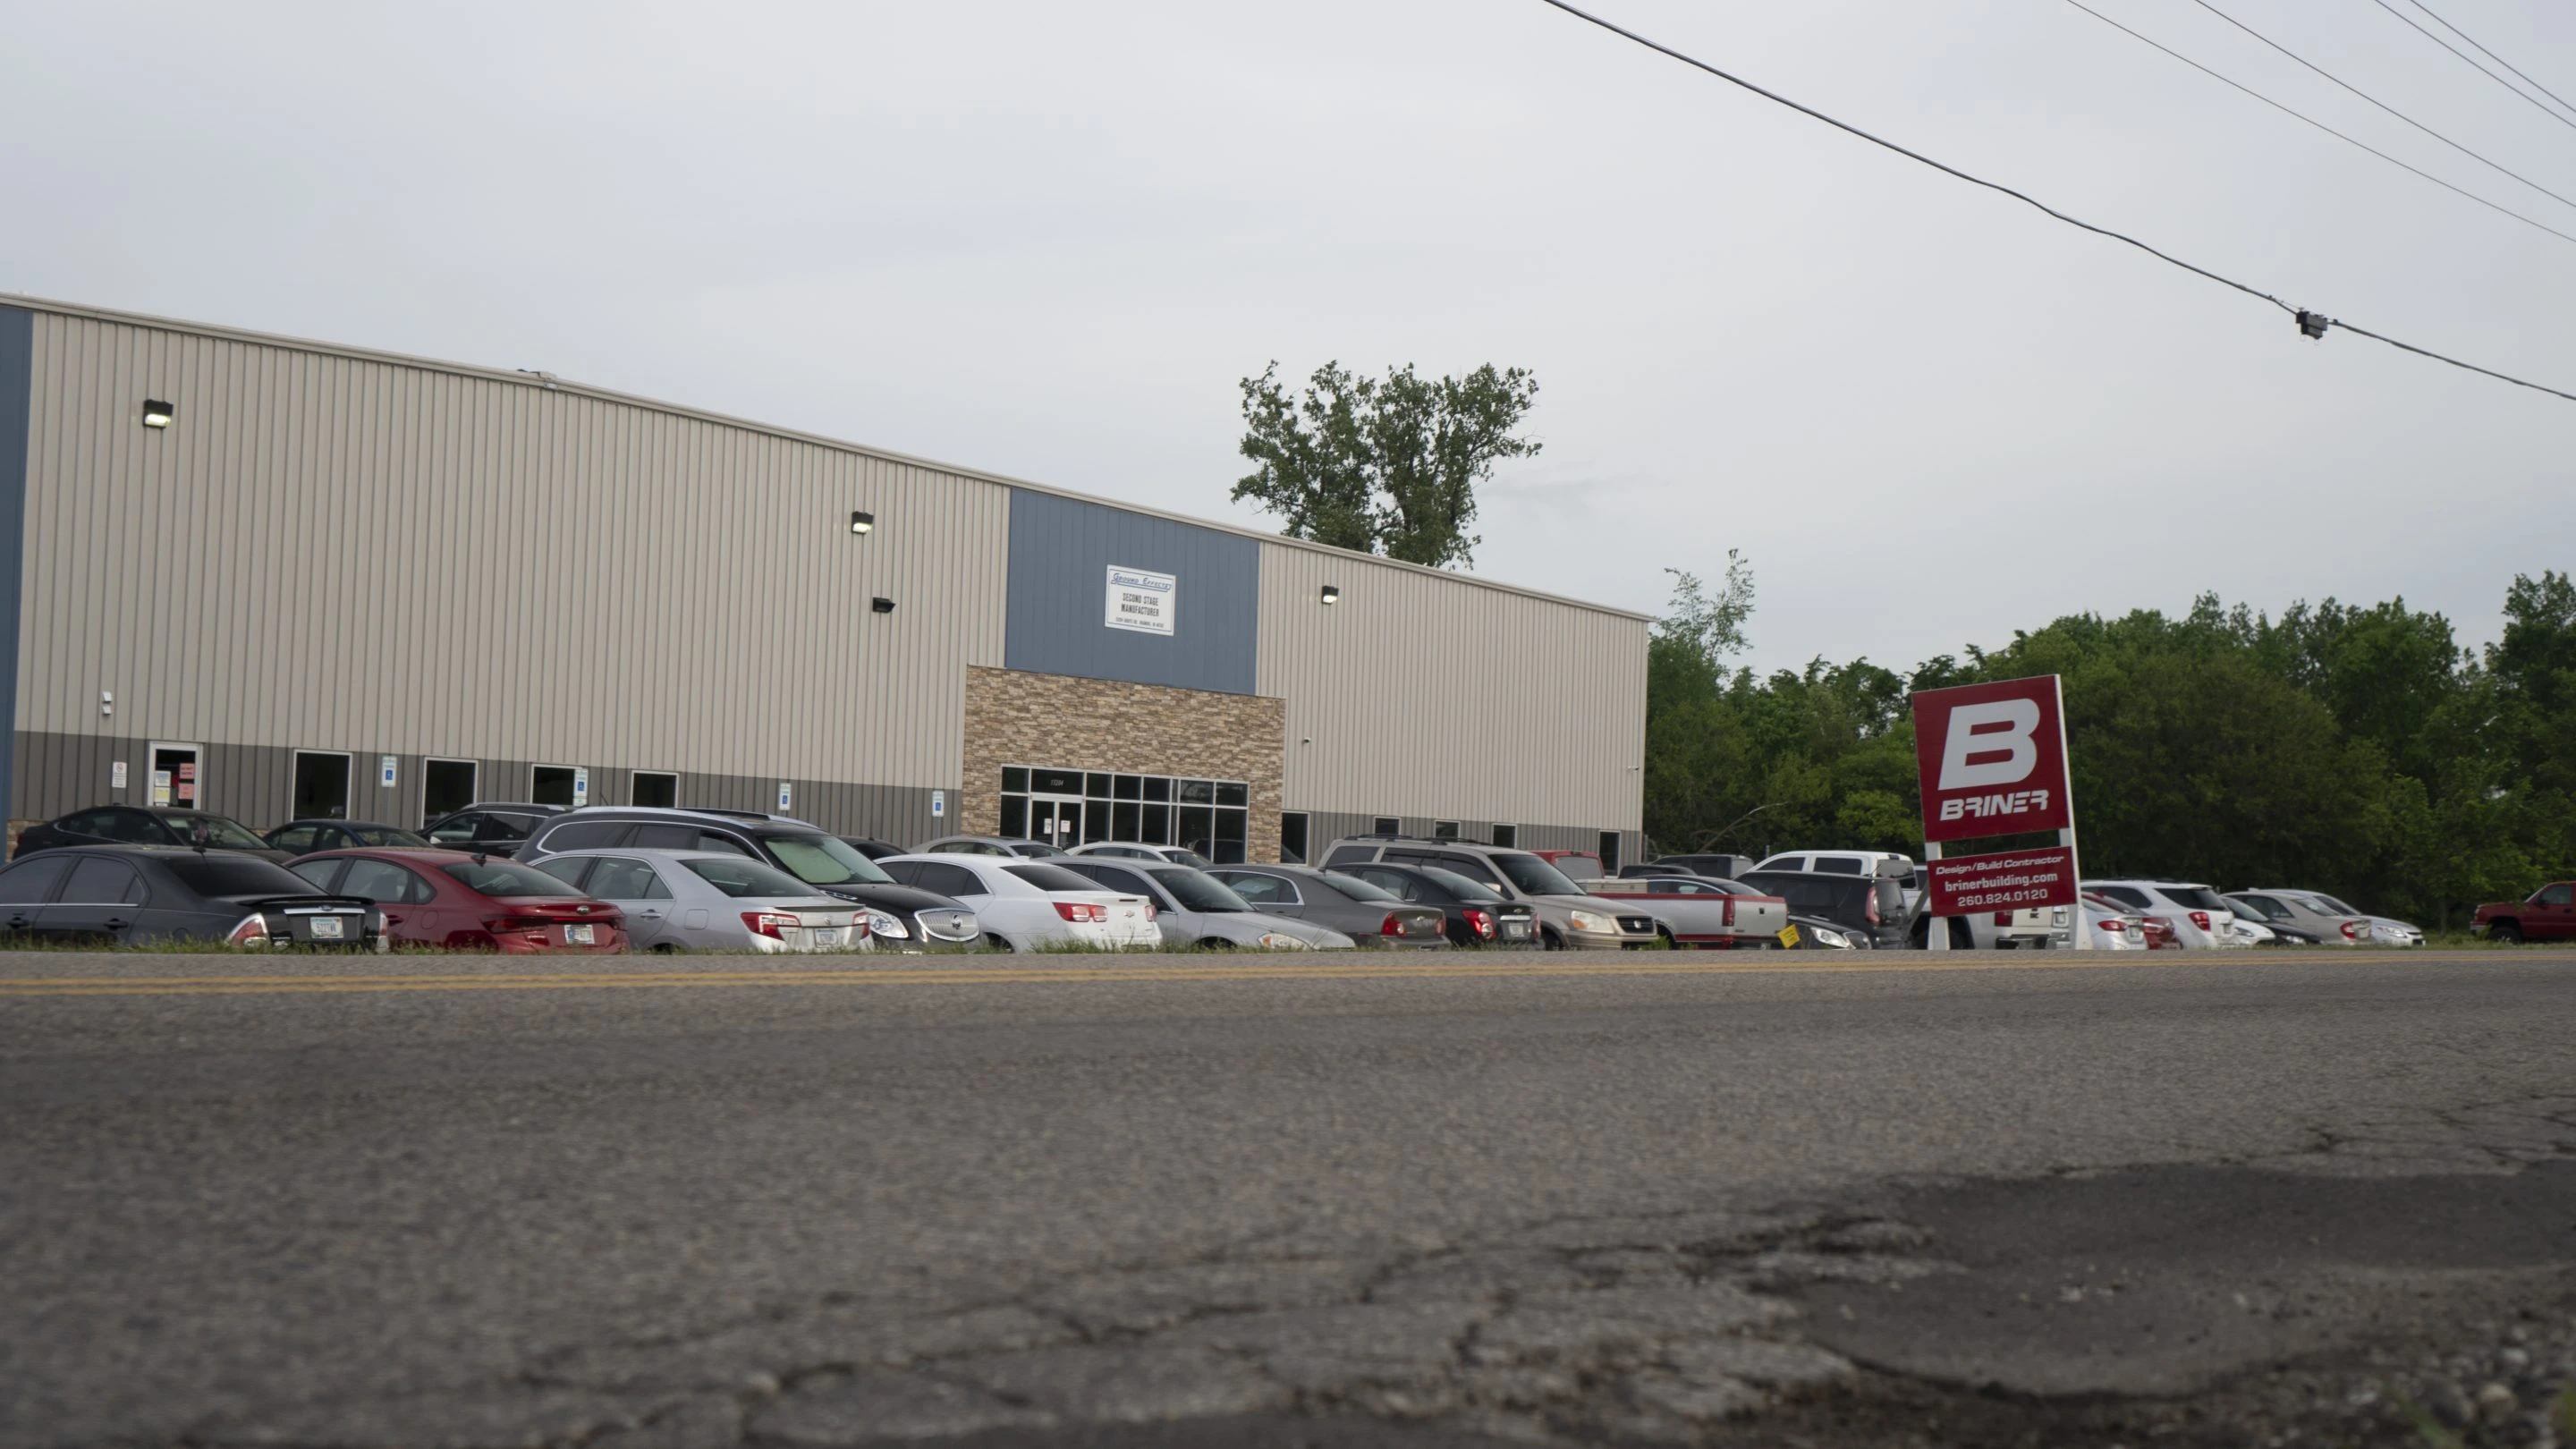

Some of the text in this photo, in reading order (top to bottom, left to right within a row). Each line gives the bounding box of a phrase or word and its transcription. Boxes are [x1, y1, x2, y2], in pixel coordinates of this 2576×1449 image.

[1123, 592, 1158, 606] SECOND STAGE
[1121, 603, 1159, 616] MANUFACTURER
[1937, 699, 2040, 790] B
[1939, 789, 2049, 821] BRINER
[1936, 856, 2064, 875] Design/Build Contractor
[1945, 873, 2058, 892] brinerbuilding.com
[1958, 888, 2048, 907] 260.824.0120
